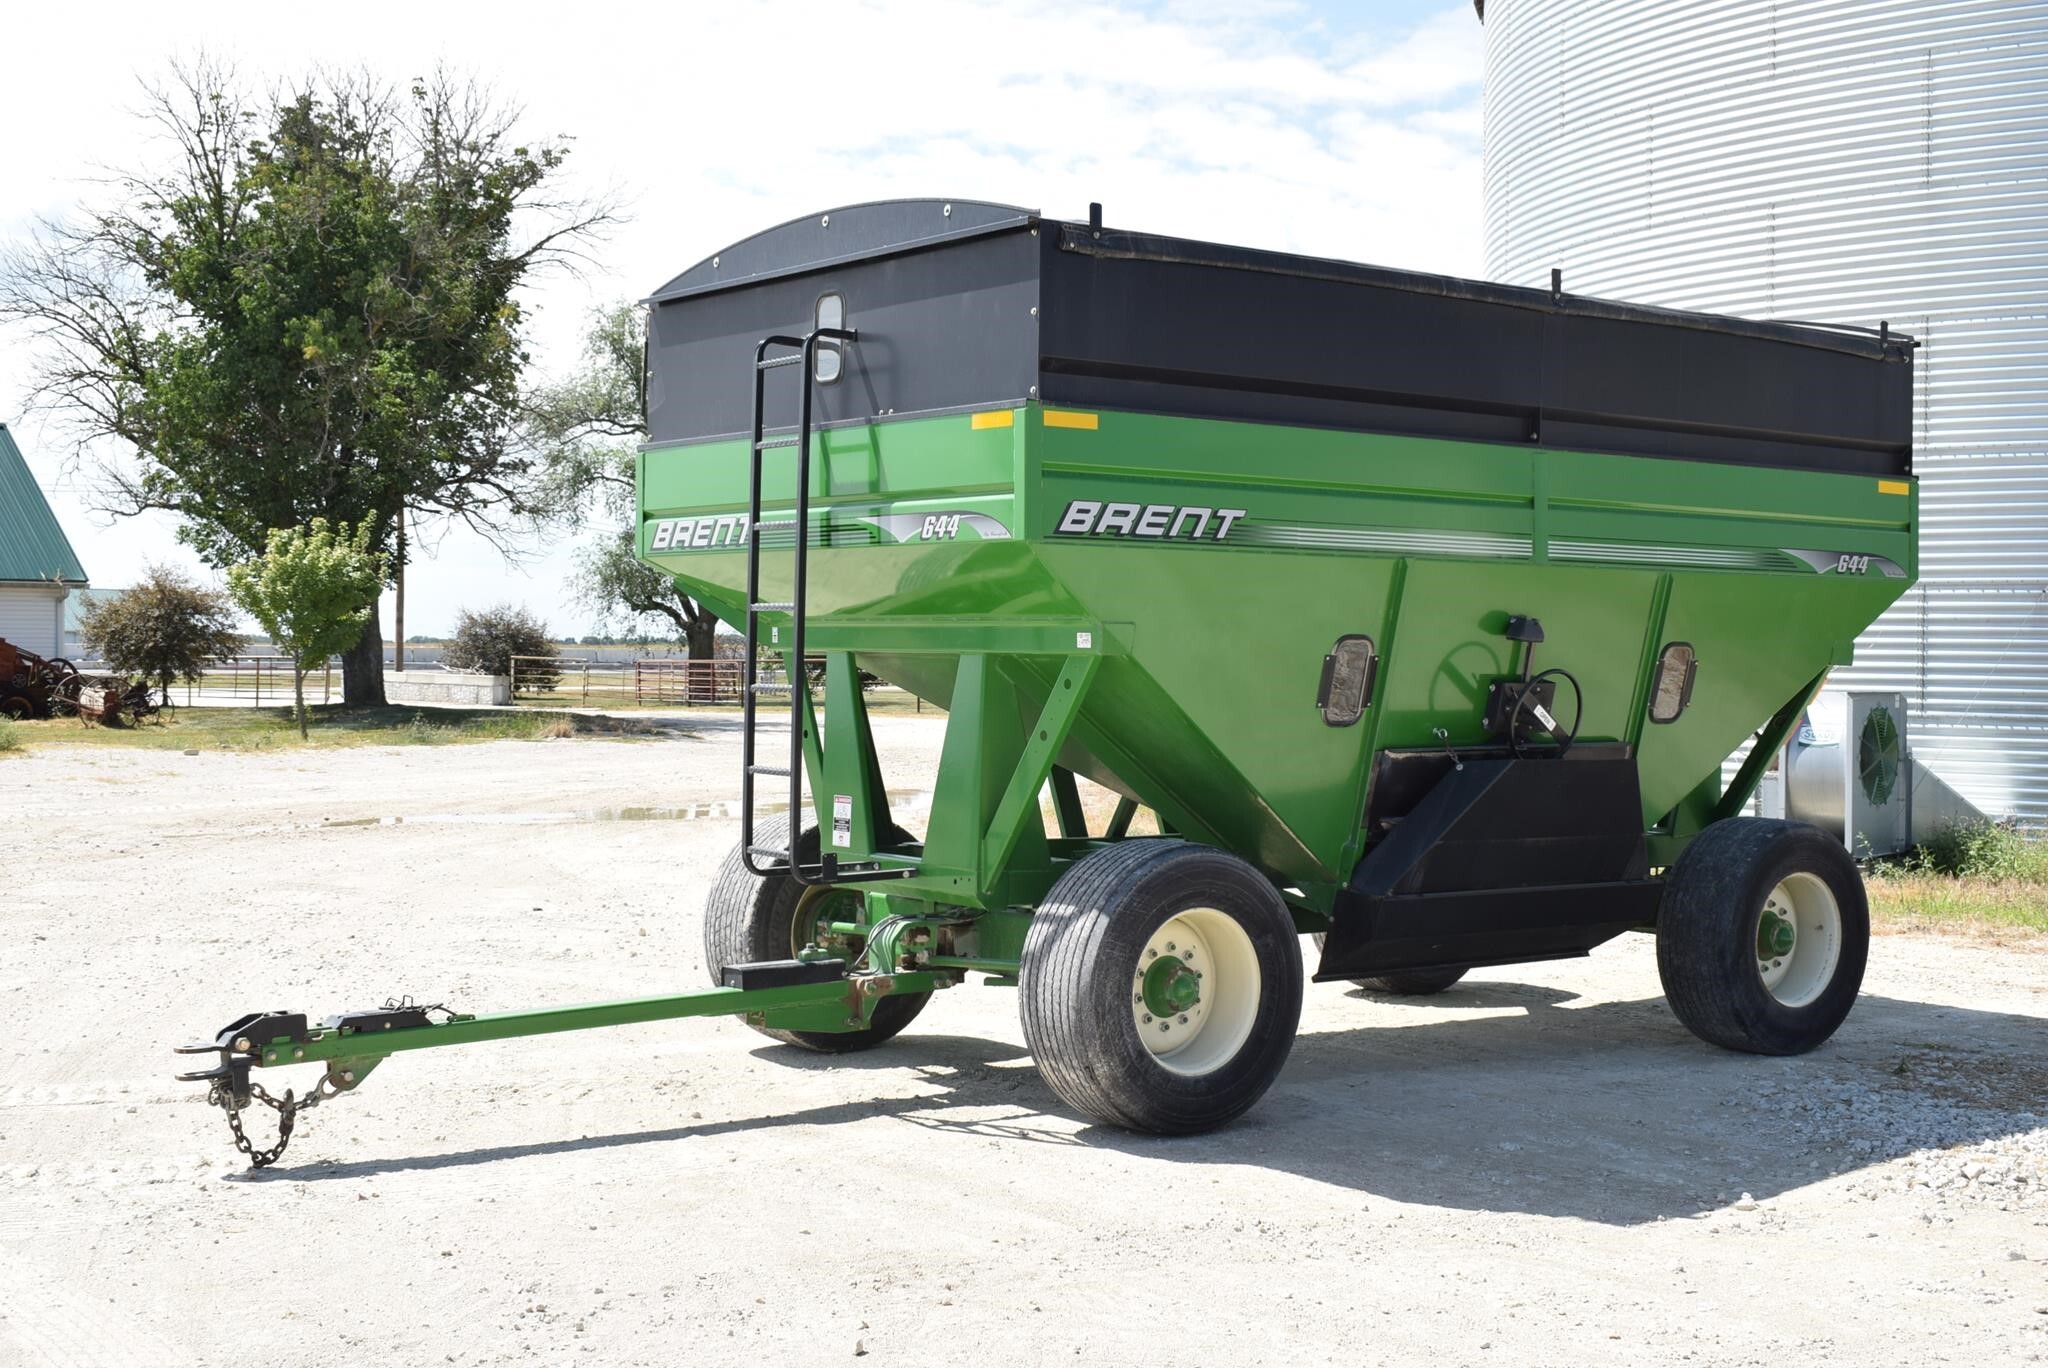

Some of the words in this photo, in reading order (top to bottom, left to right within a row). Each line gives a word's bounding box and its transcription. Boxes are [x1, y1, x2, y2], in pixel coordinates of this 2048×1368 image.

[651, 517, 750, 550] BRENT
[921, 515, 960, 540] 644
[1055, 500, 1247, 540] BRENT
[1837, 554, 1868, 574] 644
